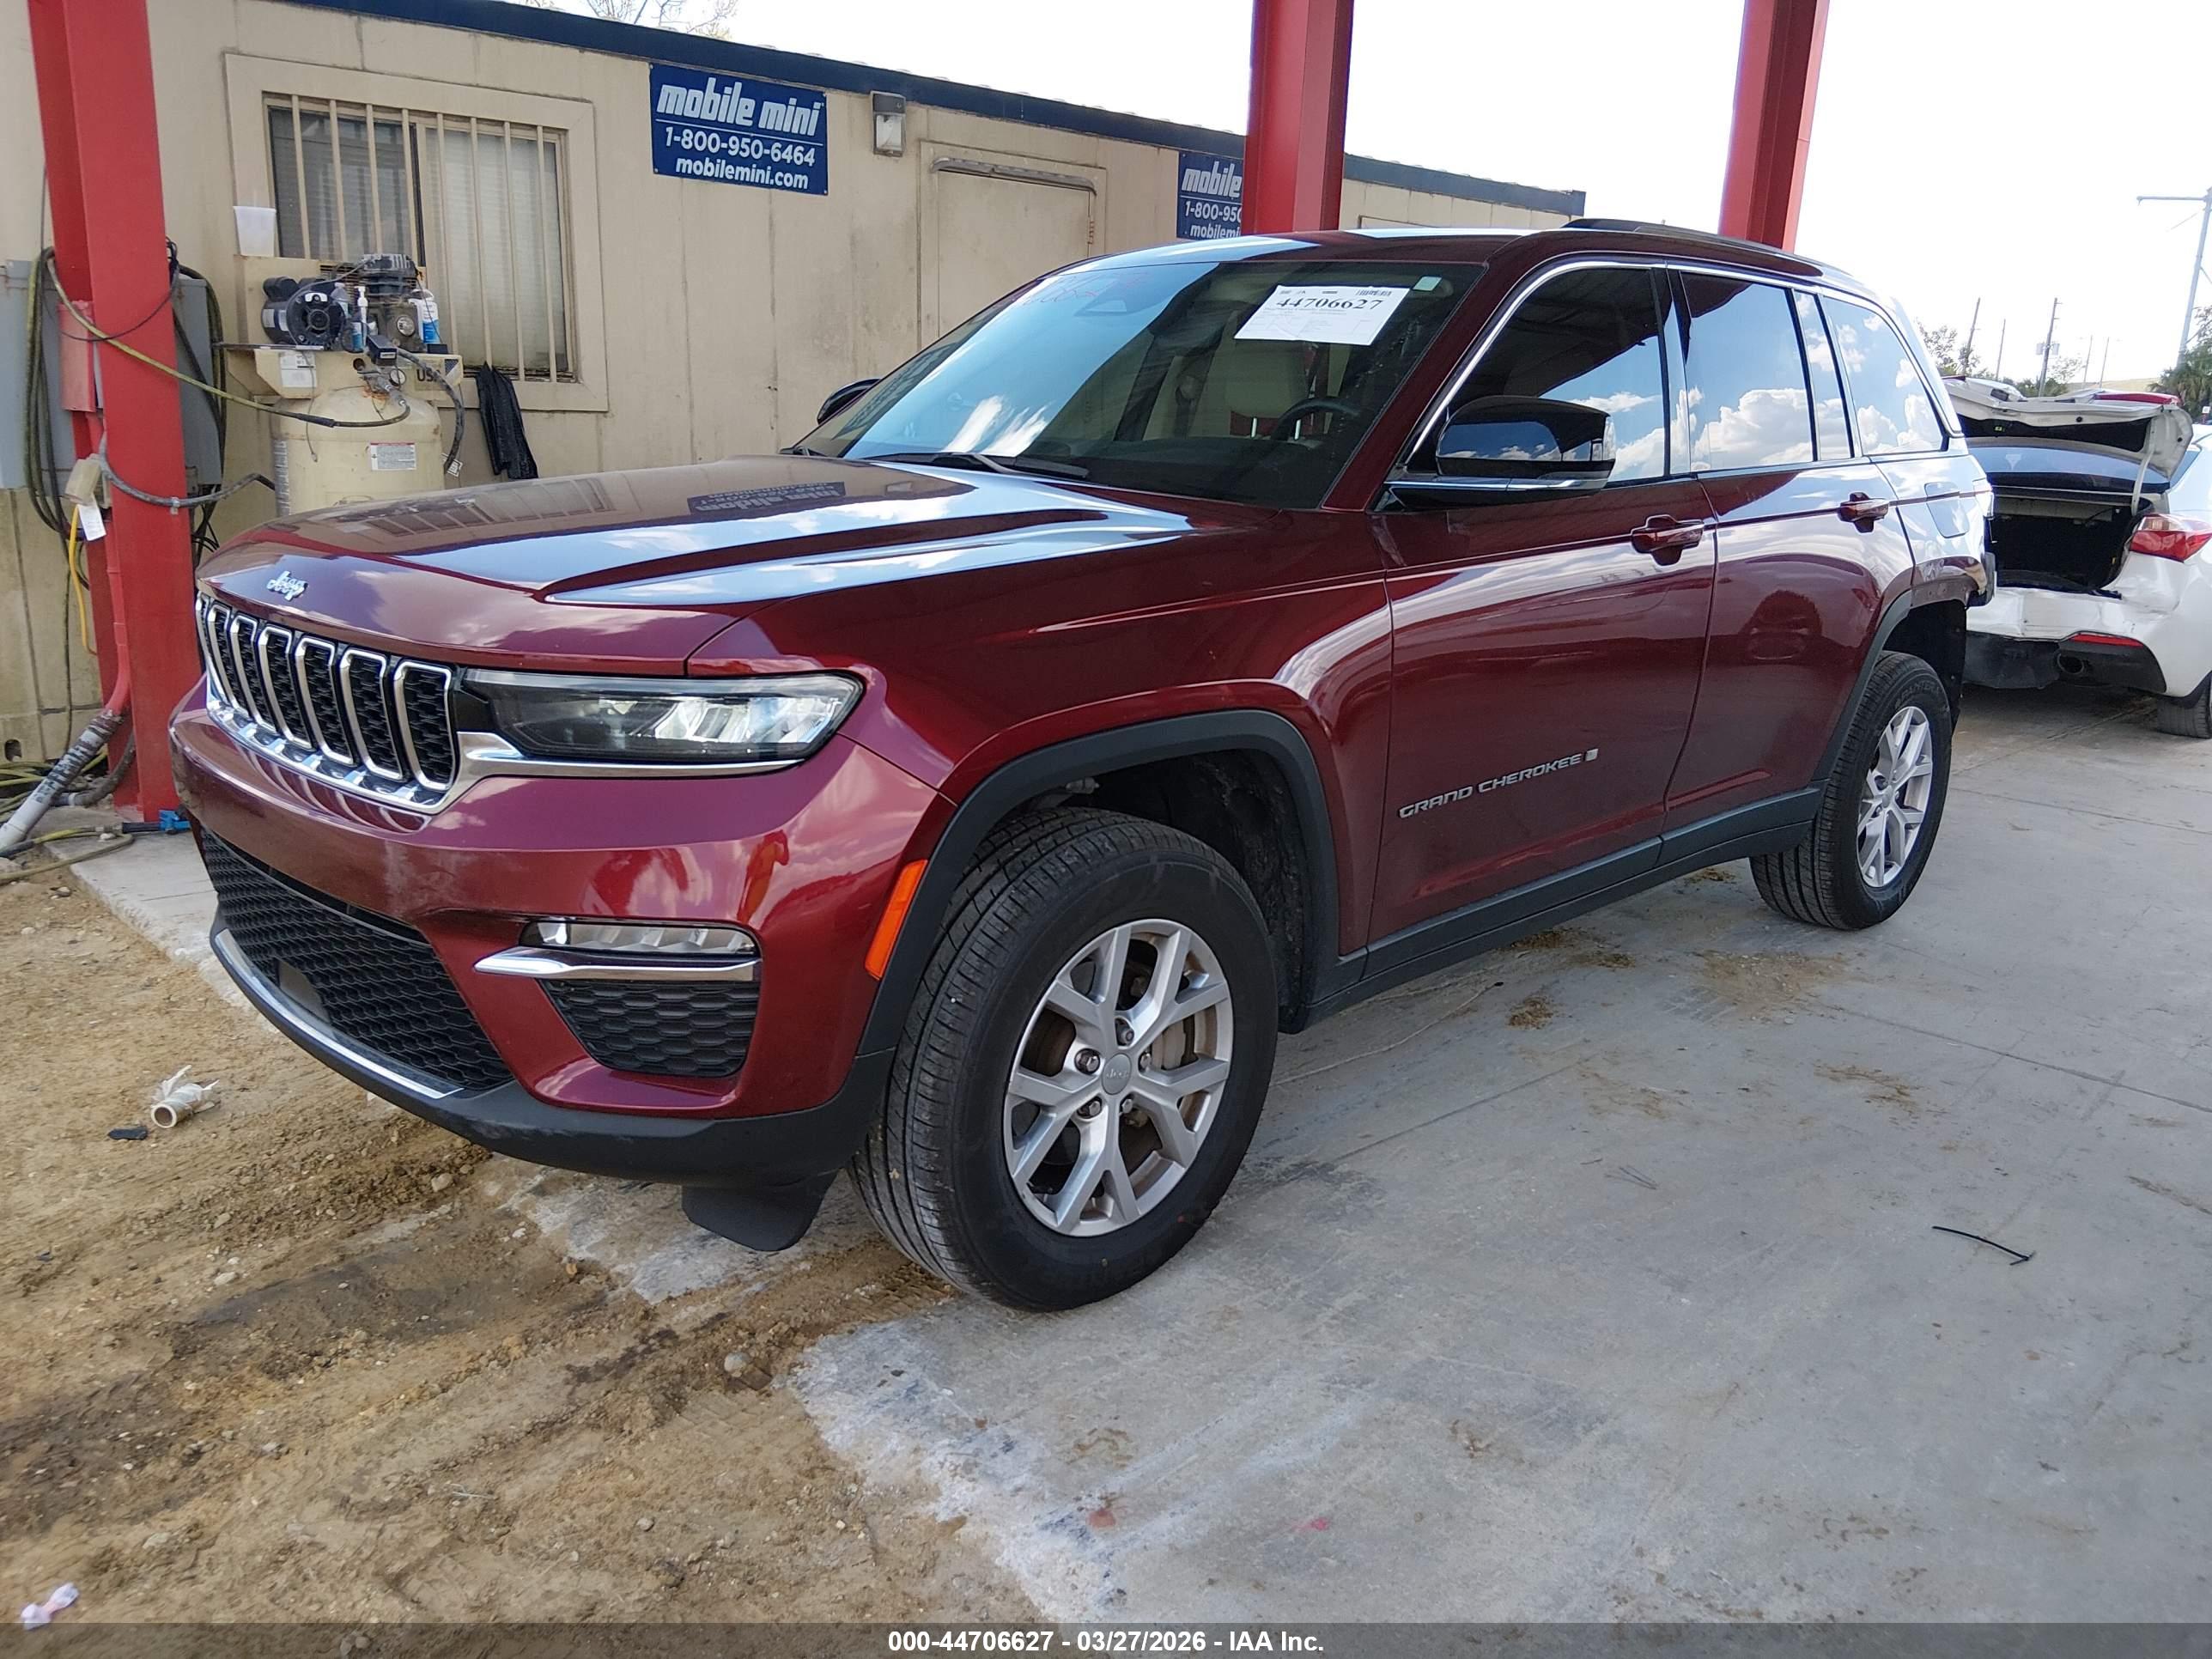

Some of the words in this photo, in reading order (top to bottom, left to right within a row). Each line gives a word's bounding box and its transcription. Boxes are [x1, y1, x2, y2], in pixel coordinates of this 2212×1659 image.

[657, 77, 756, 127] mobile
[758, 97, 822, 137] mini
[665, 126, 816, 167] 1-800-950-6464
[676, 157, 809, 190] mobilemini.com
[1182, 161, 1243, 198] mobile
[1276, 298, 1384, 310] 44706627
[416, 368, 440, 382] US
[266, 570, 306, 601] Jeep
[1399, 786, 1474, 818] GRAND
[1478, 753, 1583, 793] CHEROKEE
